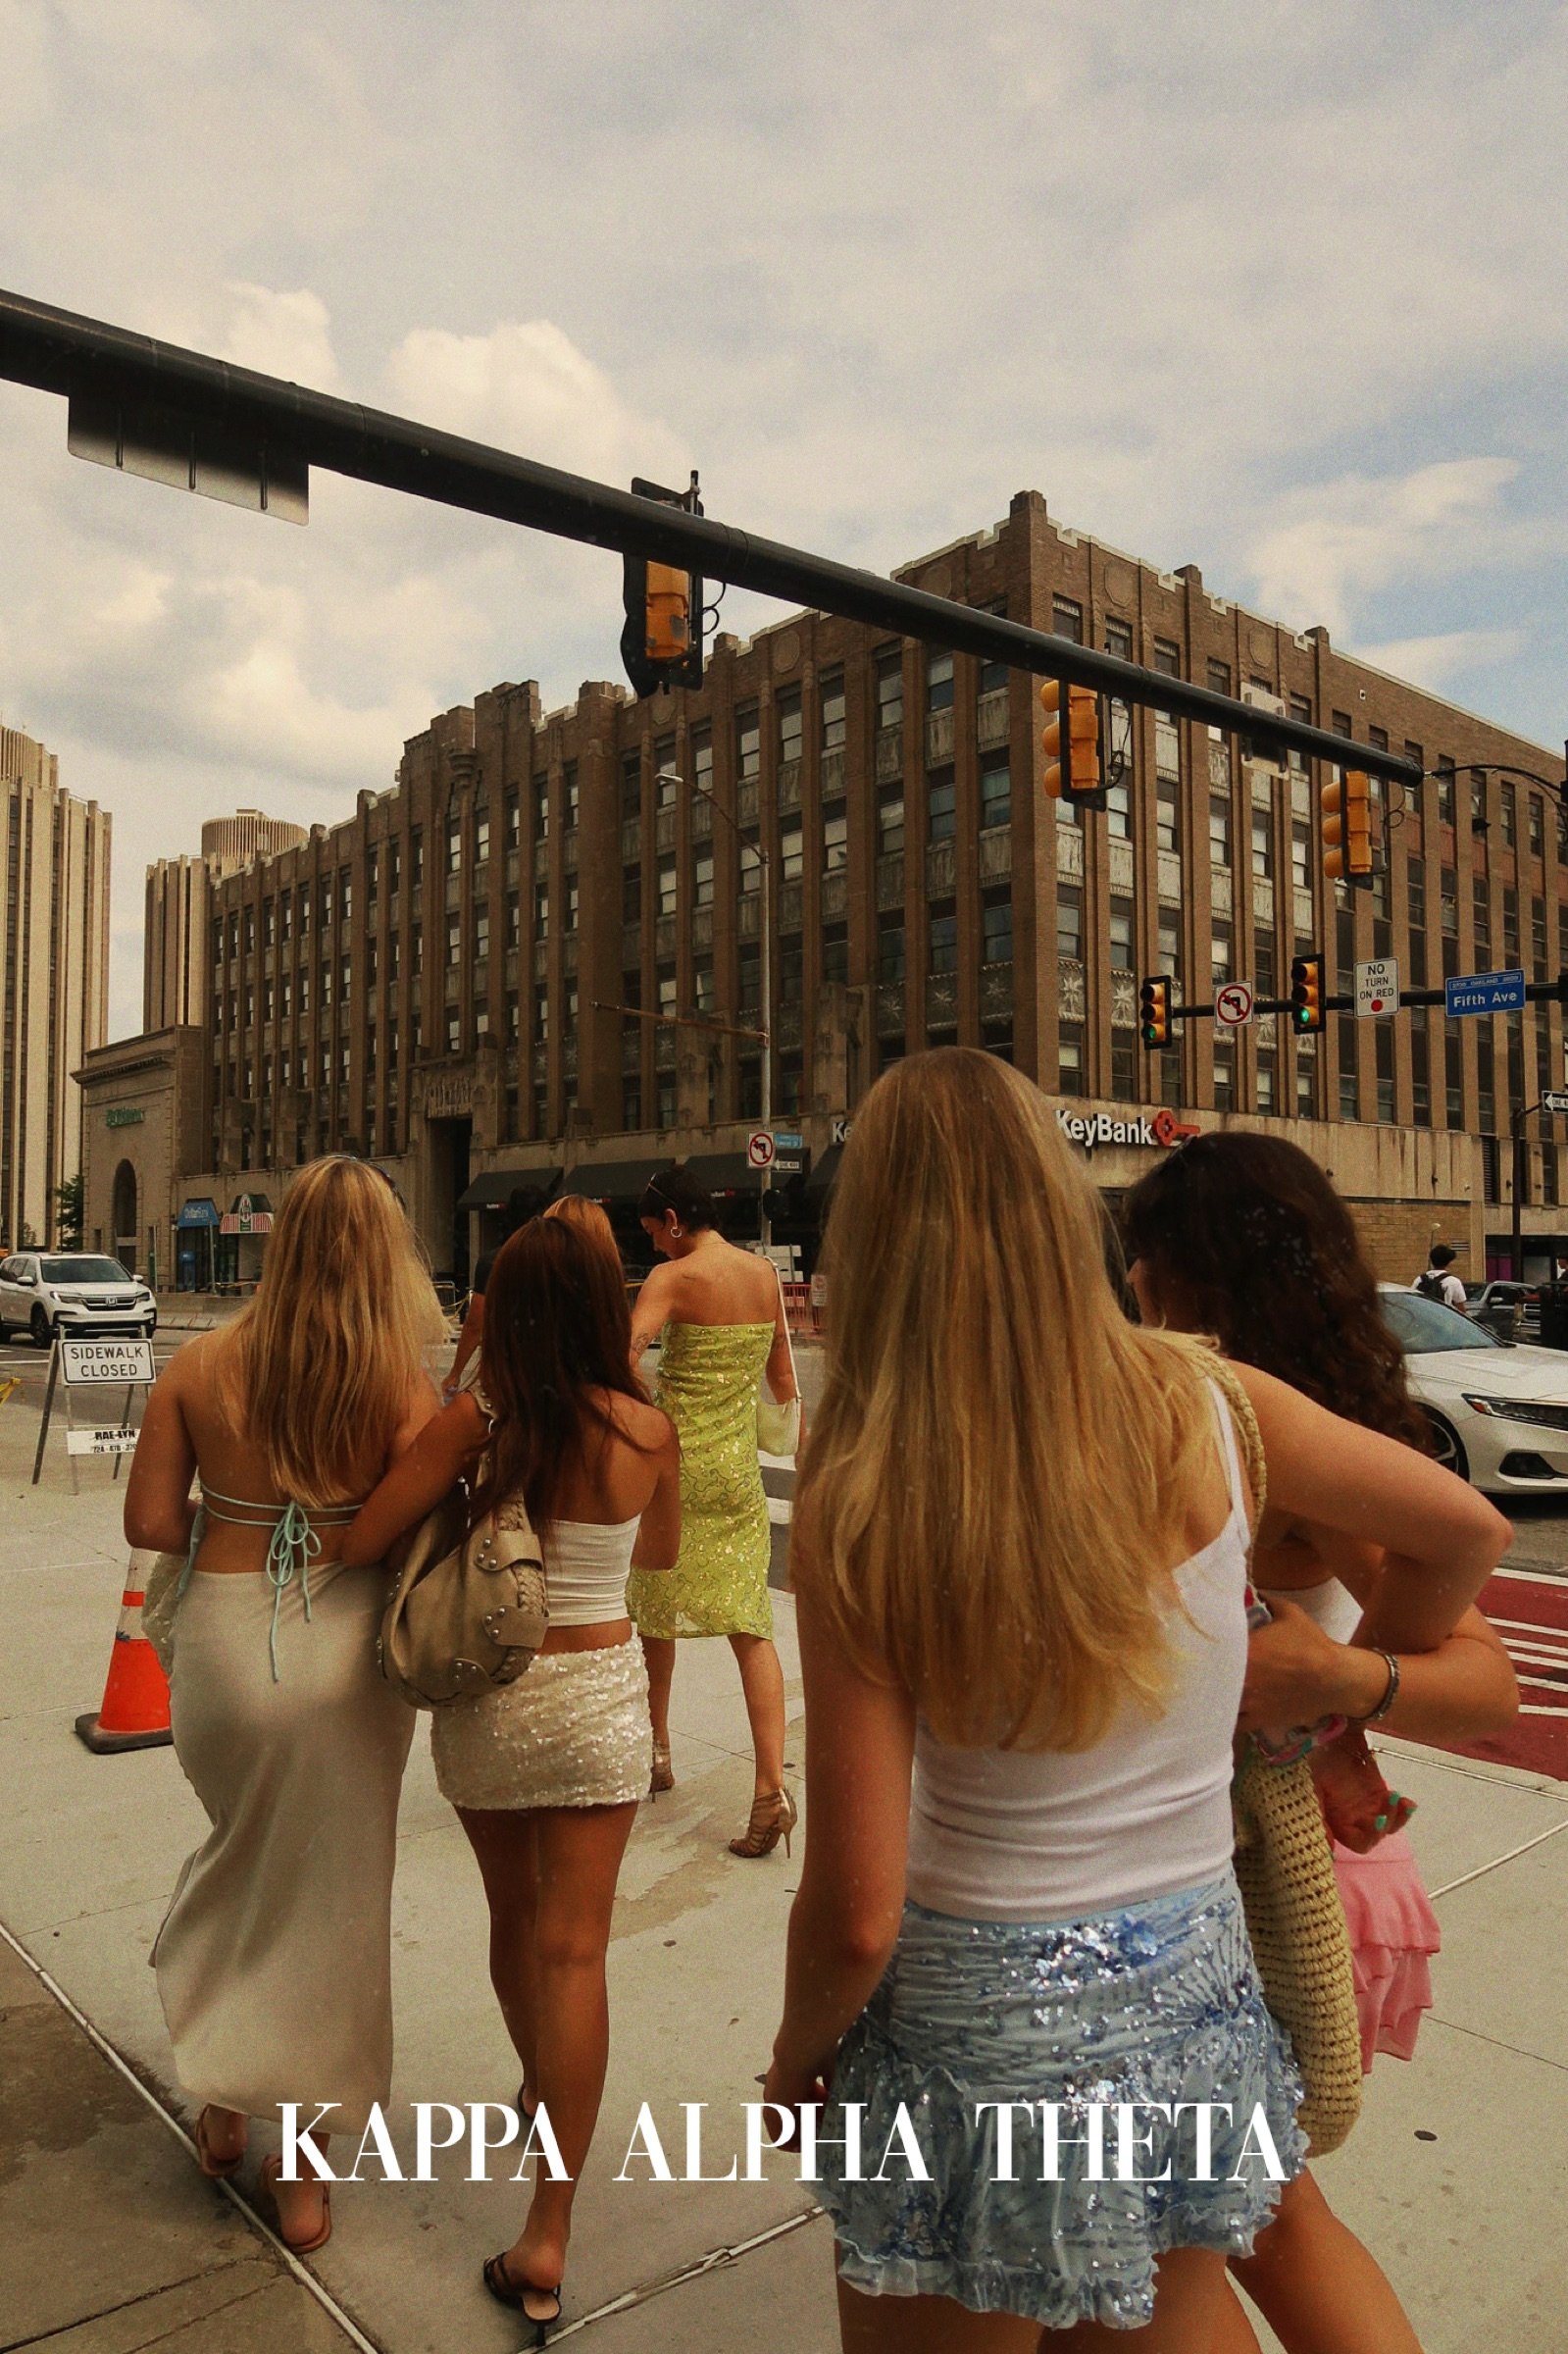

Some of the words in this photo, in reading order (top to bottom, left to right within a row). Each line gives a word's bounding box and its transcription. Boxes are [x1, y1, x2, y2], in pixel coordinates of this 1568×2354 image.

[1367, 963, 1386, 976] NO
[1365, 976, 1389, 987] TURN
[1360, 991, 1372, 1000] ON
[1376, 988, 1394, 998] RED
[1453, 994, 1486, 1008] Fifth
[1492, 991, 1518, 1003] Ave
[1056, 1109, 1153, 1147] KeyBank
[70, 1346, 144, 1359] SIDEWALK
[80, 1363, 138, 1377] CLOSED
